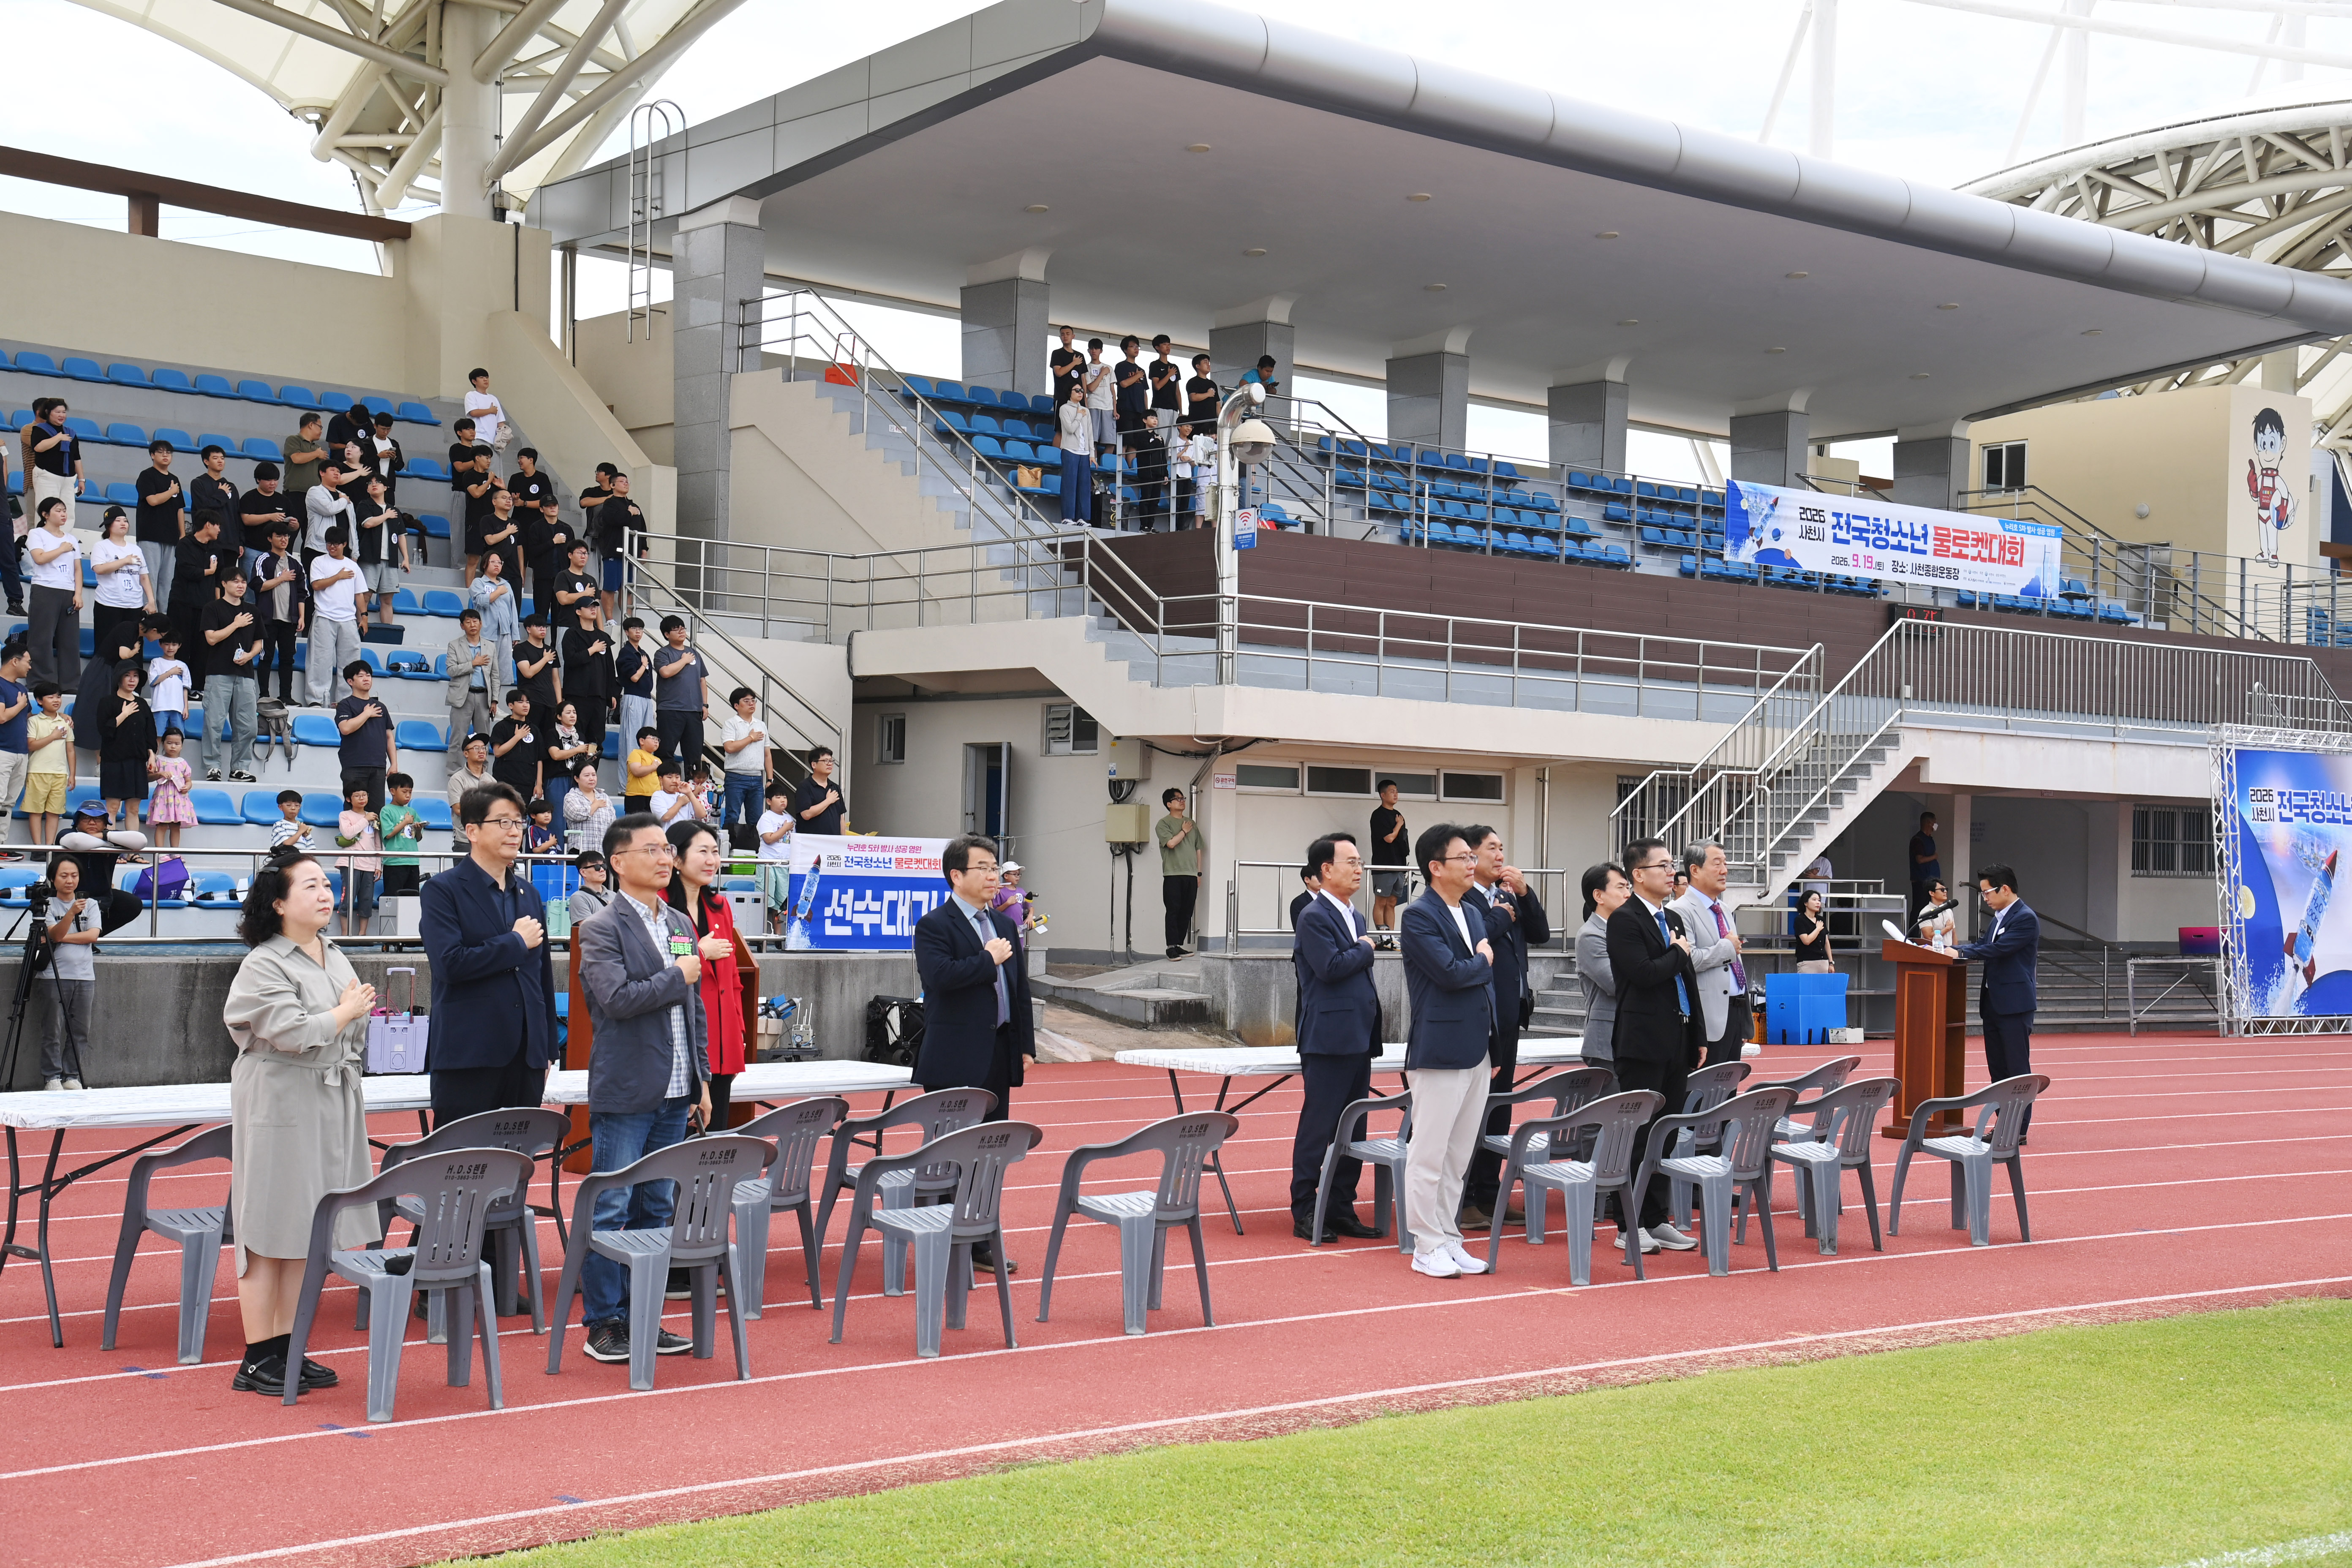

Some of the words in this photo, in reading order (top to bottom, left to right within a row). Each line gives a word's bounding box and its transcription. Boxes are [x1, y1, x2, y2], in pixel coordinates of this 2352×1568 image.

[1799, 506, 1825, 523] 2026
[1799, 525, 1825, 542] 사천시
[2004, 523, 2018, 531] 누리호
[2019, 524, 2026, 533] 5차
[2027, 525, 2036, 534] 발사
[2036, 527, 2045, 536] 성공
[2046, 528, 2055, 536] 염원
[1831, 512, 1928, 555] 전국청소년
[1933, 525, 2025, 567] 물로켓대회
[1831, 556, 1850, 566] 2026.
[1852, 553, 1860, 568] 9.
[59, 564, 67, 572] 177
[1892, 560, 1908, 574] 장소:
[1910, 563, 1960, 580] 사천종합운동장
[2250, 789, 2273, 802] 2026
[2252, 807, 2274, 822] 사천시
[847, 844, 866, 852] 누리호
[868, 844, 879, 852] 5차
[880, 845, 893, 853] 발사
[895, 845, 908, 853] 성공
[909, 846, 922, 854] 염원
[844, 856, 892, 869] 전국청소년
[894, 857, 942, 870] 물로켓대회
[824, 889, 950, 936] 선수대기
[670, 942, 692, 955] 최동환
[798, 1108, 825, 1119] H.D.S렌탈
[495, 1120, 530, 1130] H.D.S렌탈
[700, 1149, 737, 1160] H.D.S렌탈
[447, 1163, 488, 1174] H.D.S렌탈
